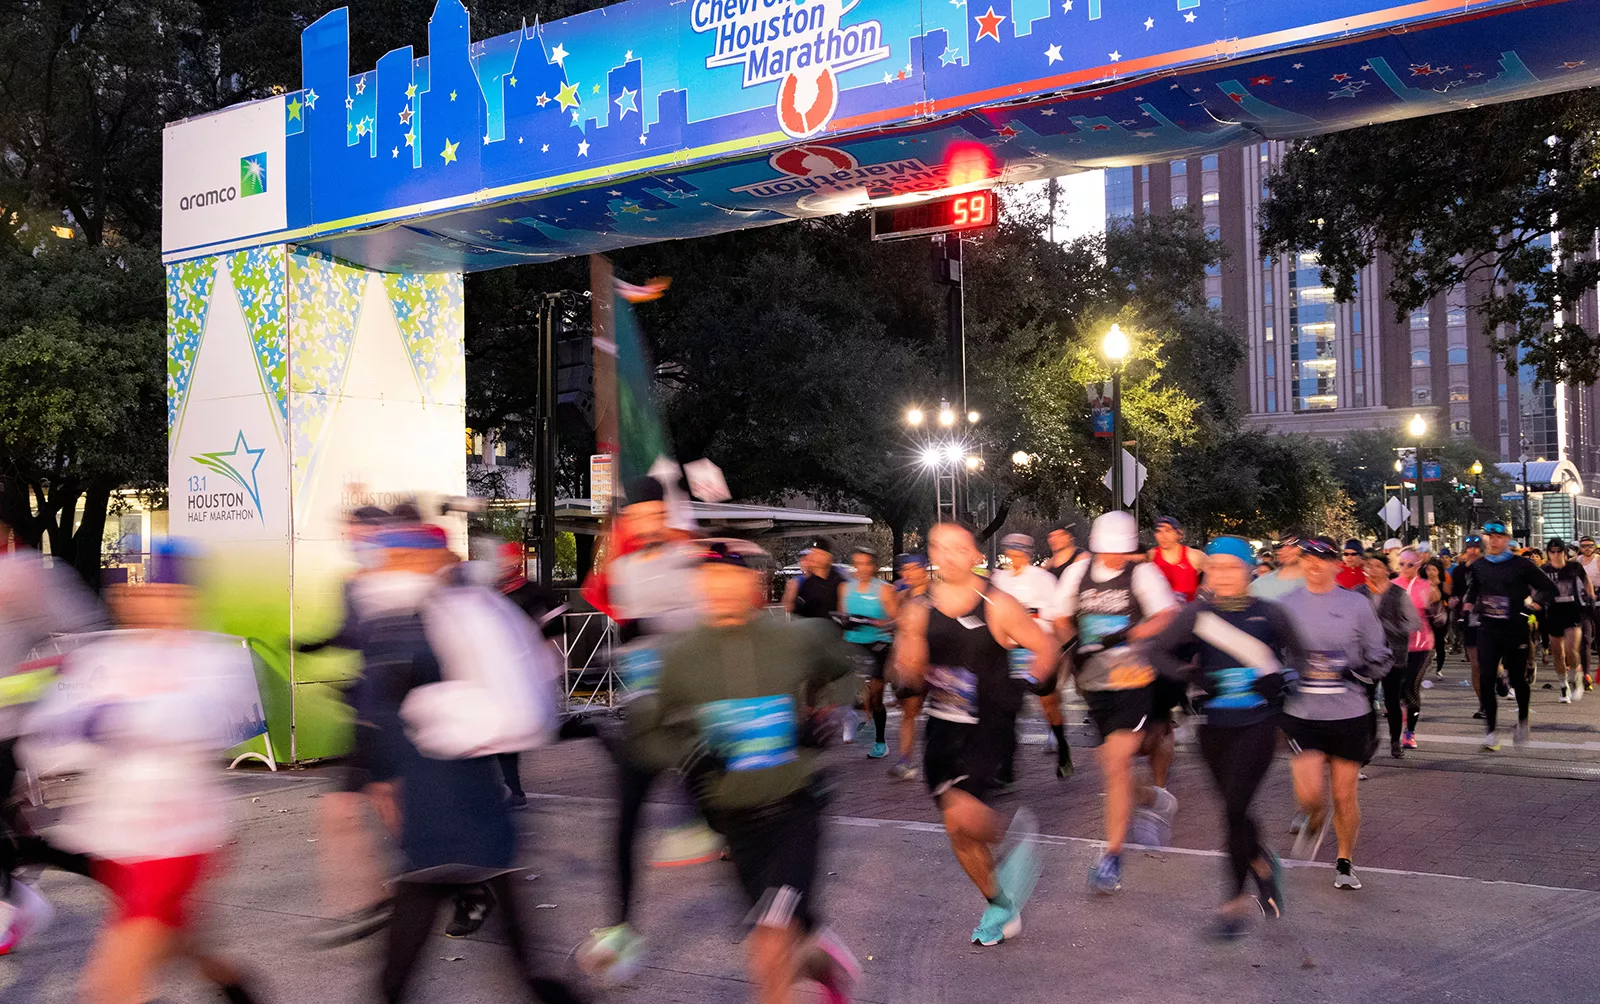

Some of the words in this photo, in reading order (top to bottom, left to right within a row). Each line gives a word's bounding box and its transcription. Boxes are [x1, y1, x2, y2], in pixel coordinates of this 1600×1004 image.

[719, 3, 825, 56] Houston
[747, 25, 877, 82] Marathon
[751, 159, 924, 196] Marathon
[179, 186, 236, 211] aramco
[954, 197, 985, 225] 59
[187, 475, 207, 492] 13.1
[187, 492, 244, 510] HOUSTON
[341, 491, 401, 506] HOUSTON
[187, 511, 208, 522] HALF
[209, 509, 254, 521] MARATHON
